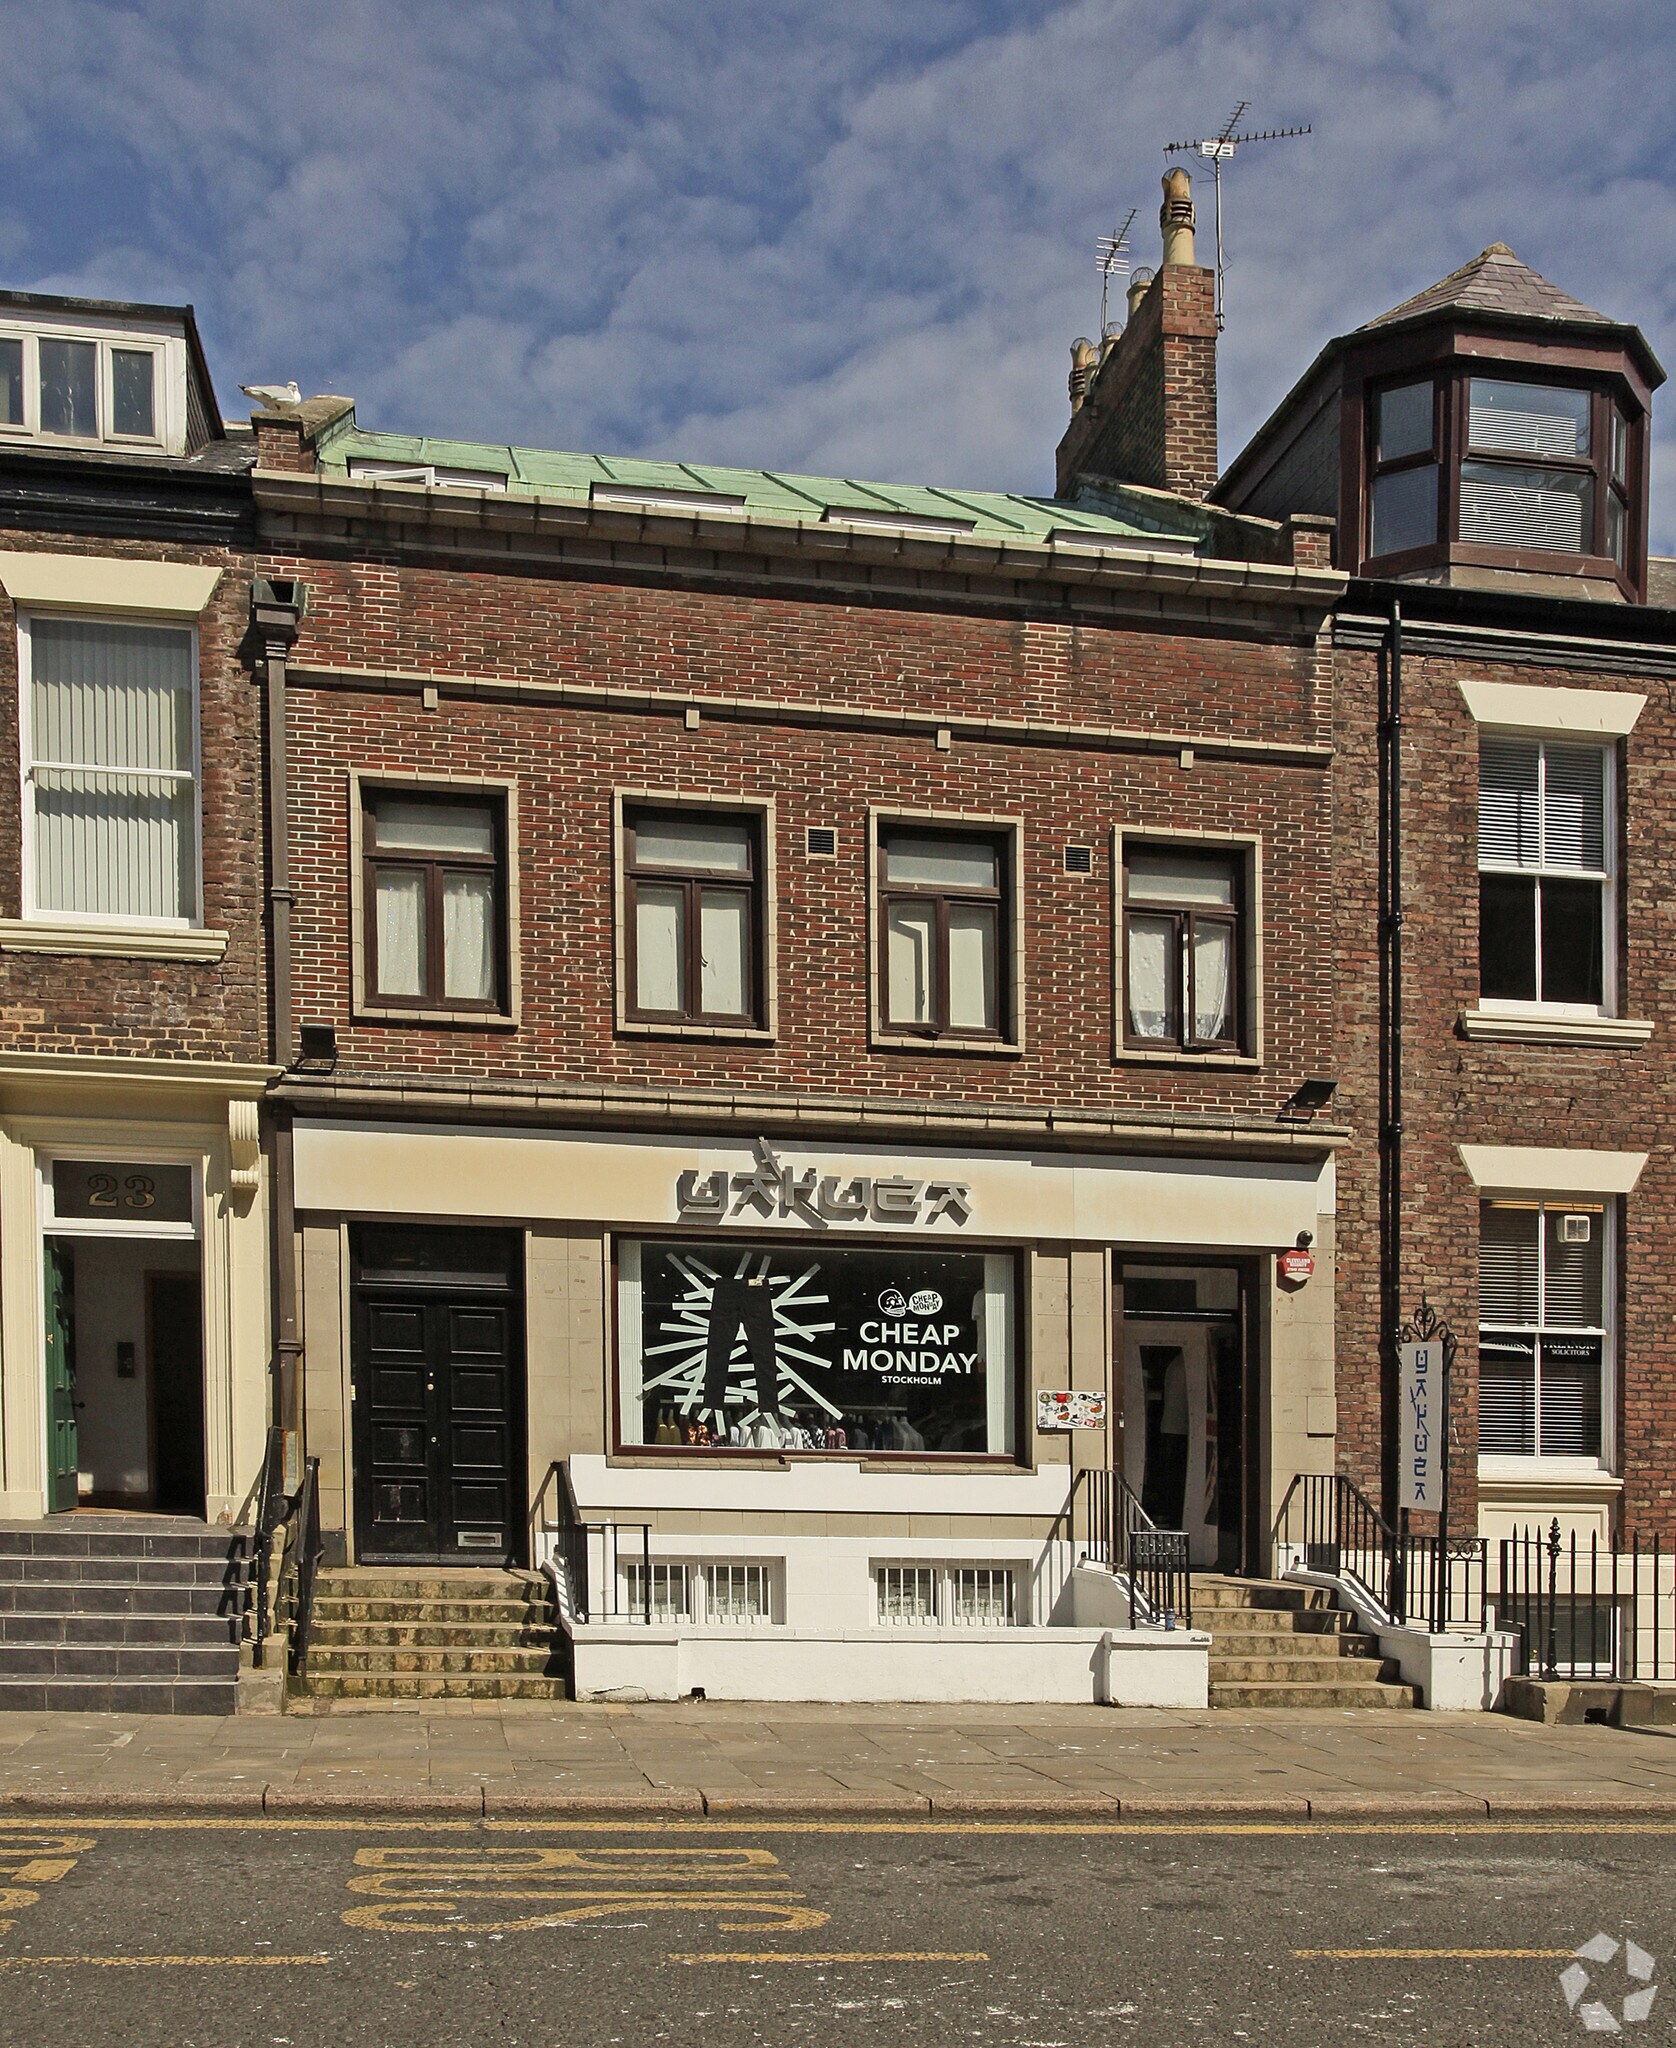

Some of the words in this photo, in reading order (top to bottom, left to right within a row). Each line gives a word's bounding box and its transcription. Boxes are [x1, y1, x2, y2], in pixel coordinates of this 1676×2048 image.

[88, 1173, 155, 1208] 23
[912, 1293, 938, 1305] CHEAP
[913, 1300, 940, 1311] MONDAY
[859, 1321, 960, 1345] CHEAP
[1551, 1348, 1590, 1356] SOLICITORS
[843, 1349, 978, 1374] MONDAY
[881, 1375, 942, 1385] STOCKHOLM
[340, 1847, 831, 1933] BUS
